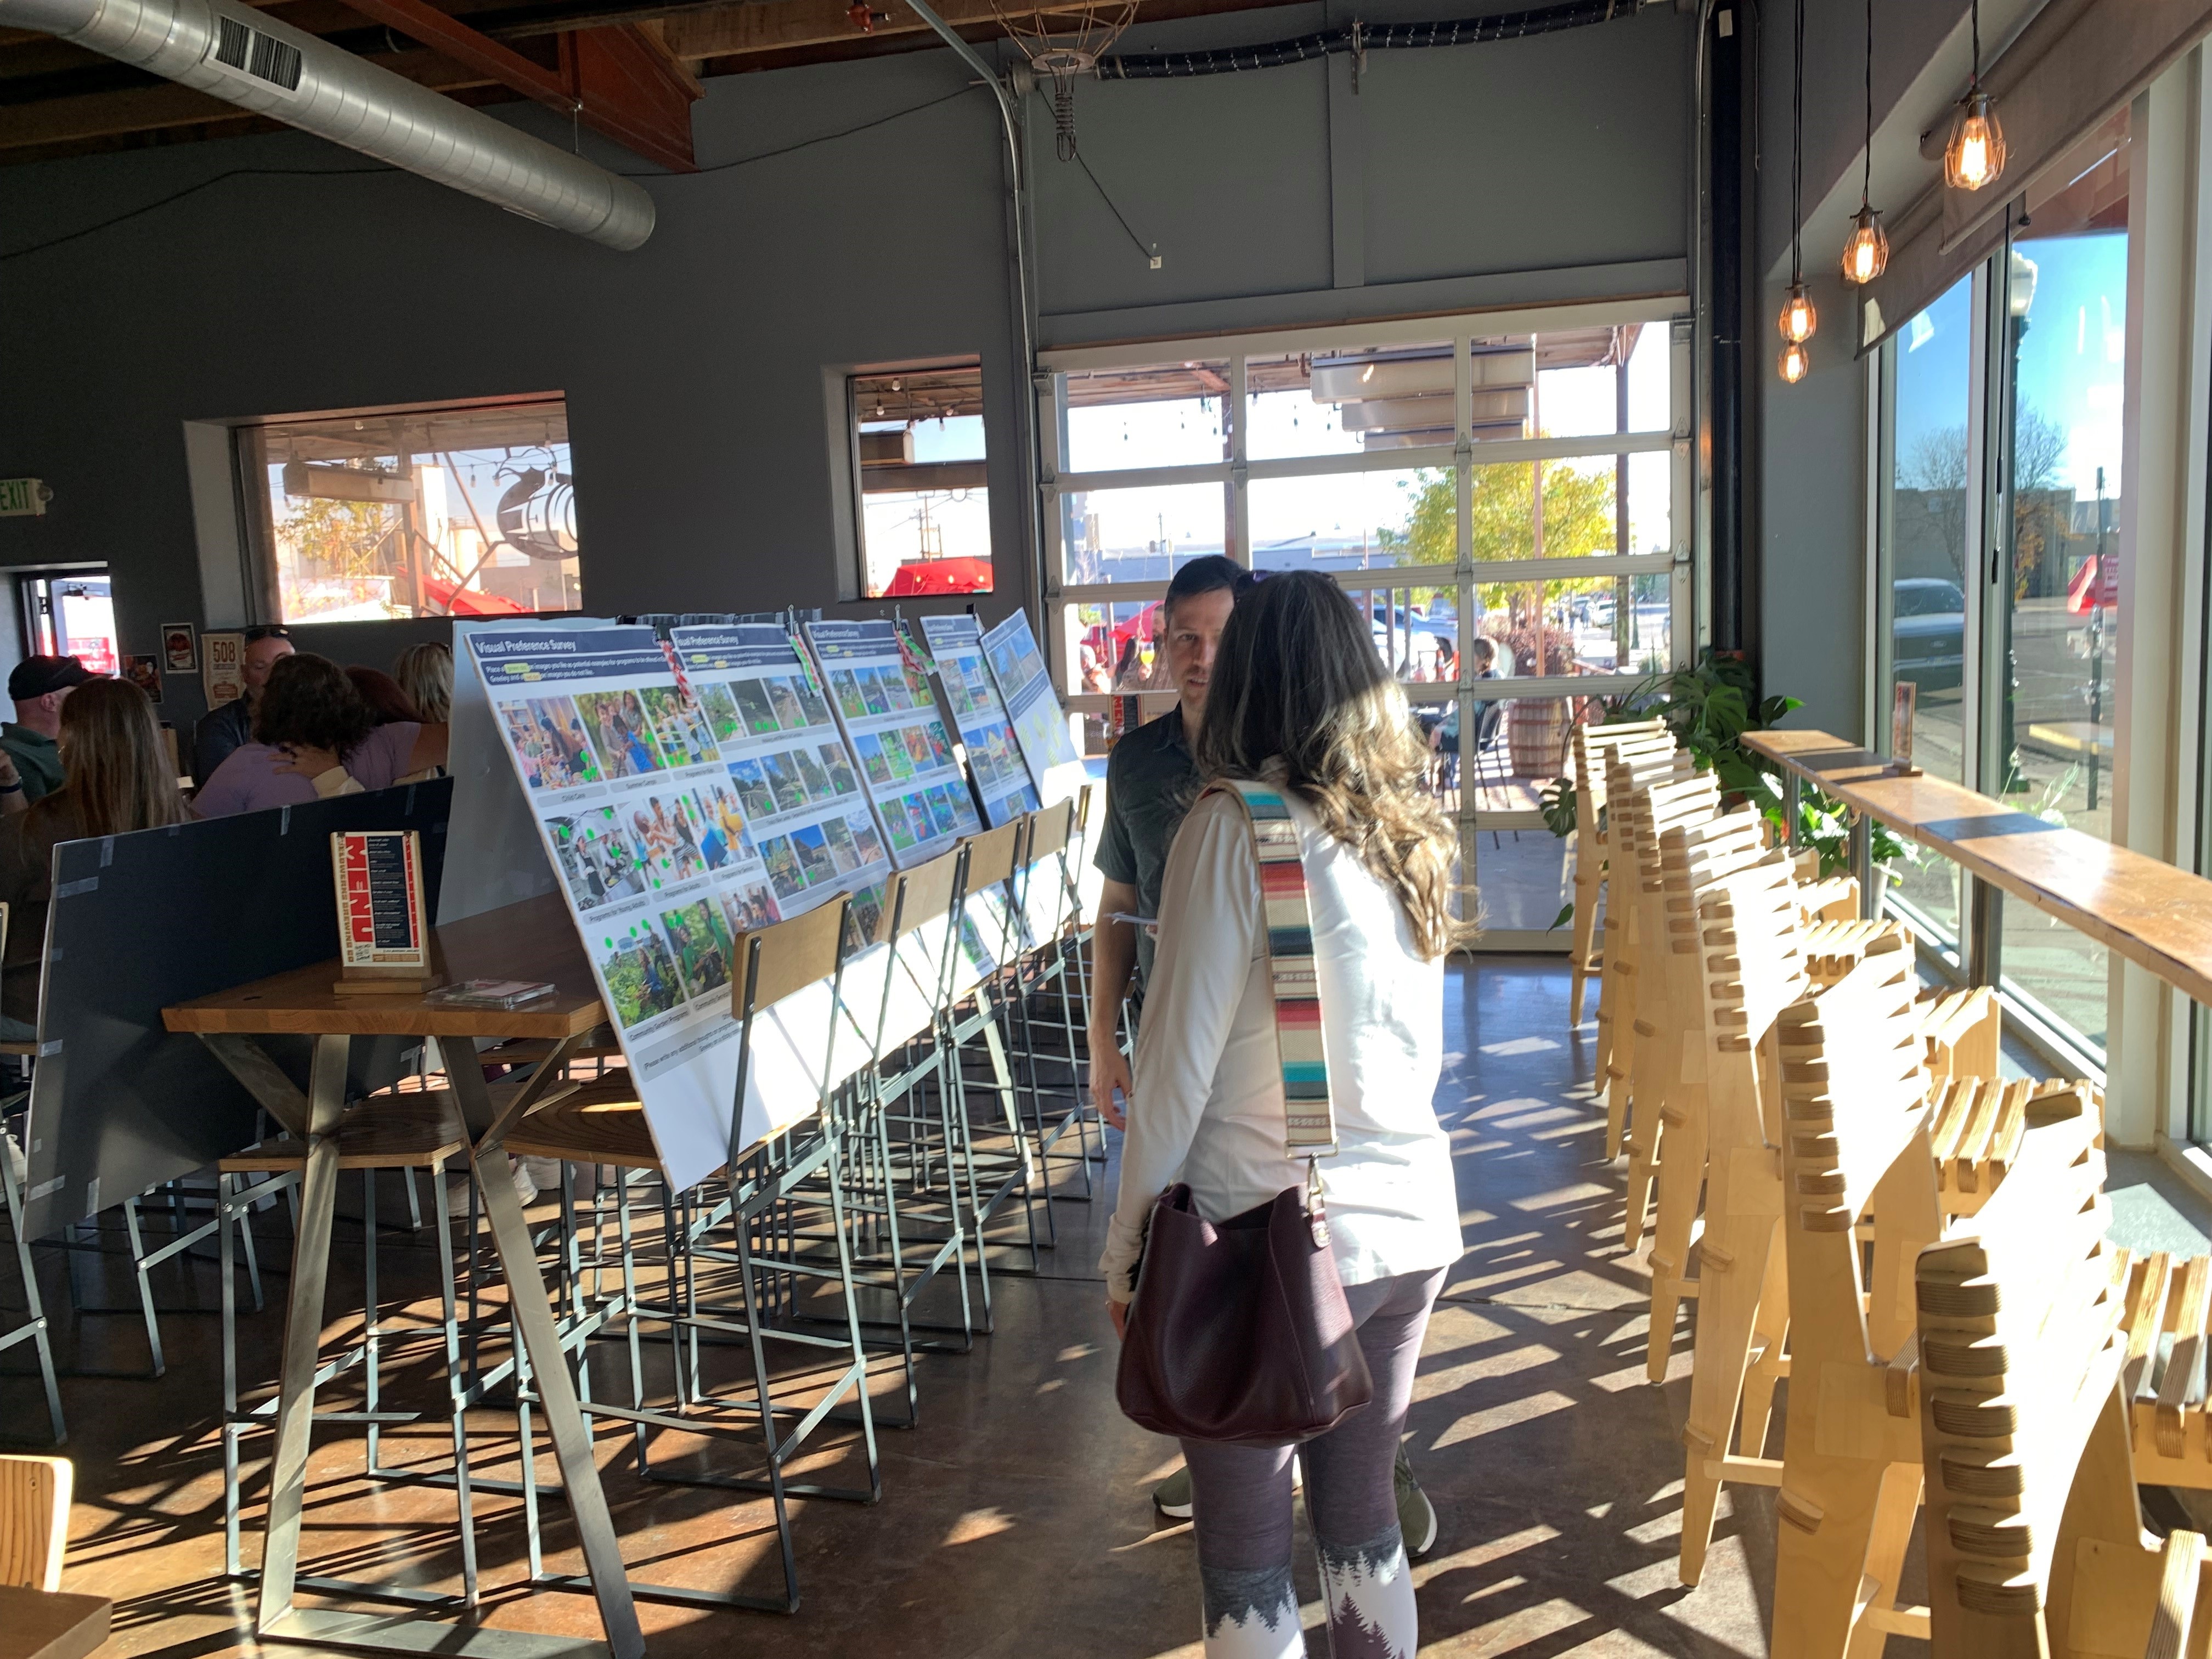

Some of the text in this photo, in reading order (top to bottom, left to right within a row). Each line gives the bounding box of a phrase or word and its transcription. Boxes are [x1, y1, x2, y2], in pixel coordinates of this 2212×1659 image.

[0, 481, 29, 510] EXIT
[475, 639, 576, 653] Visual Preference Survey
[690, 636, 719, 645] Preference
[719, 635, 739, 645] Survey
[213, 641, 235, 663] 508
[345, 836, 374, 943] MENU
[589, 912, 610, 923] Programs
[630, 1027, 654, 1041] Community
[669, 1010, 689, 1022] Programs
[644, 1058, 659, 1070] Please
